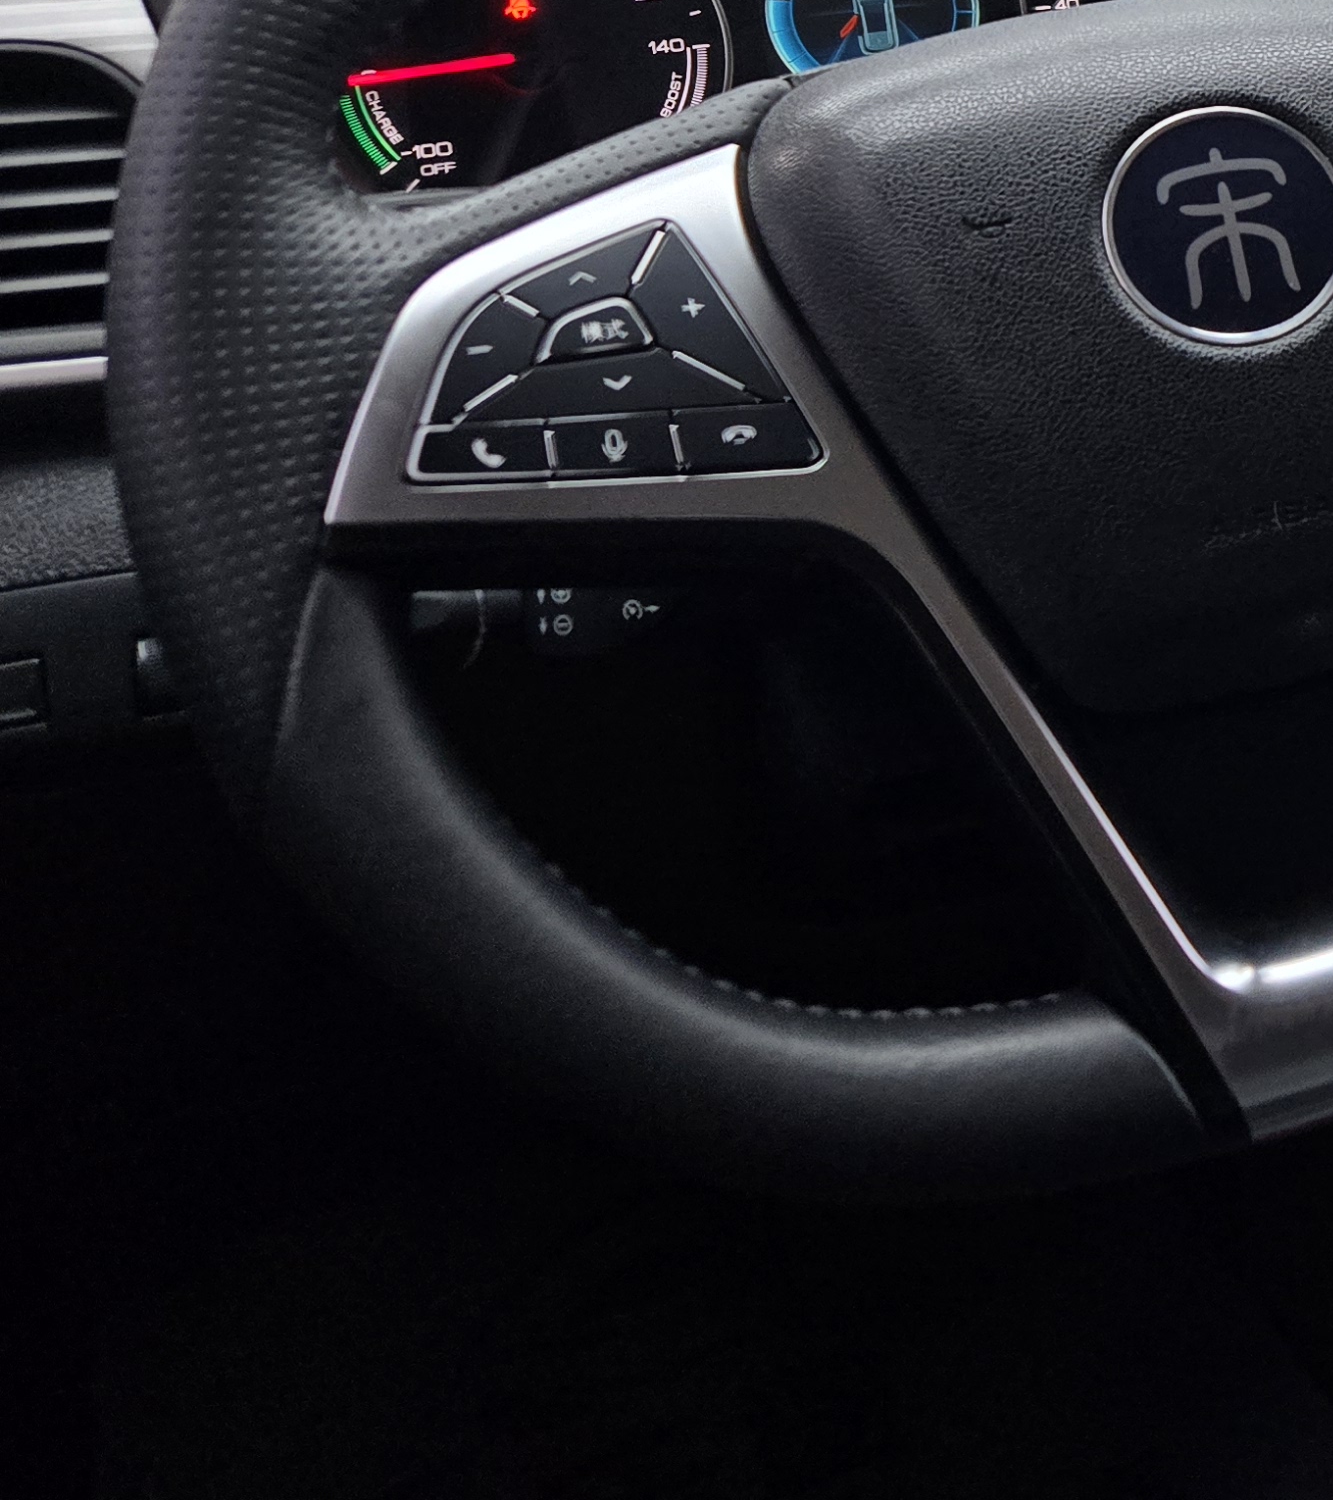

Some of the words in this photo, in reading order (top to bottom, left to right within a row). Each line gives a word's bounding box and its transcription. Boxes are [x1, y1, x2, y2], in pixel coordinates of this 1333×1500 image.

[648, 37, 685, 55] 140
[660, 71, 683, 117] BOOST
[365, 90, 405, 145] CHARGE
[420, 161, 457, 176] OFF
